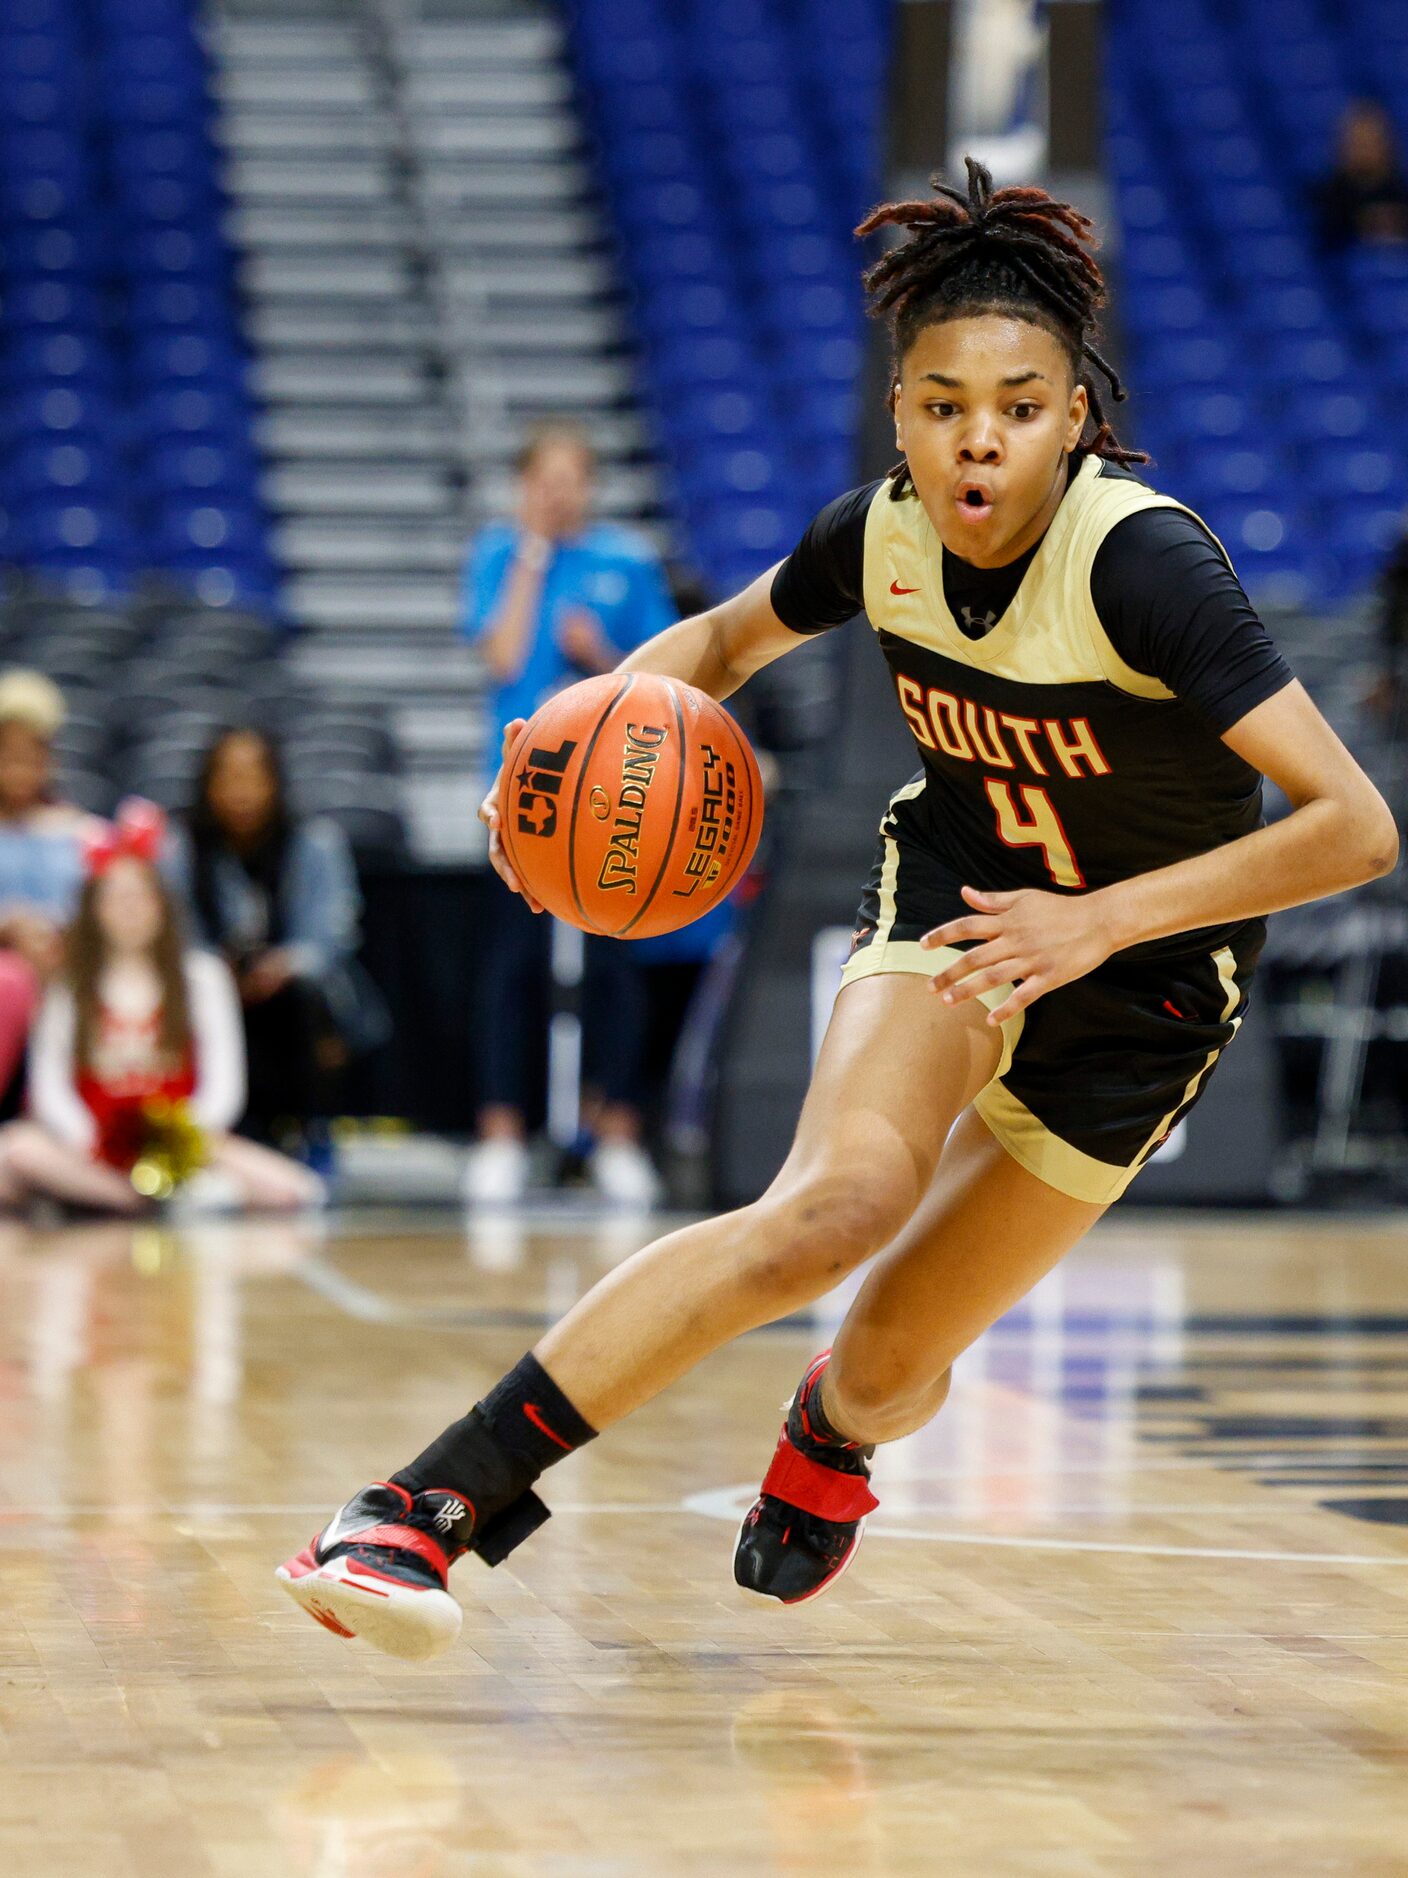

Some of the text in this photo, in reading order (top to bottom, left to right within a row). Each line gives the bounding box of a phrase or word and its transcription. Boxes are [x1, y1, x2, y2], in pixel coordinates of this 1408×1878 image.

[897, 673, 1113, 778] SOUTH
[597, 722, 668, 896] SPALDING
[672, 744, 723, 897] LEGACY
[983, 776, 1087, 889] 4
